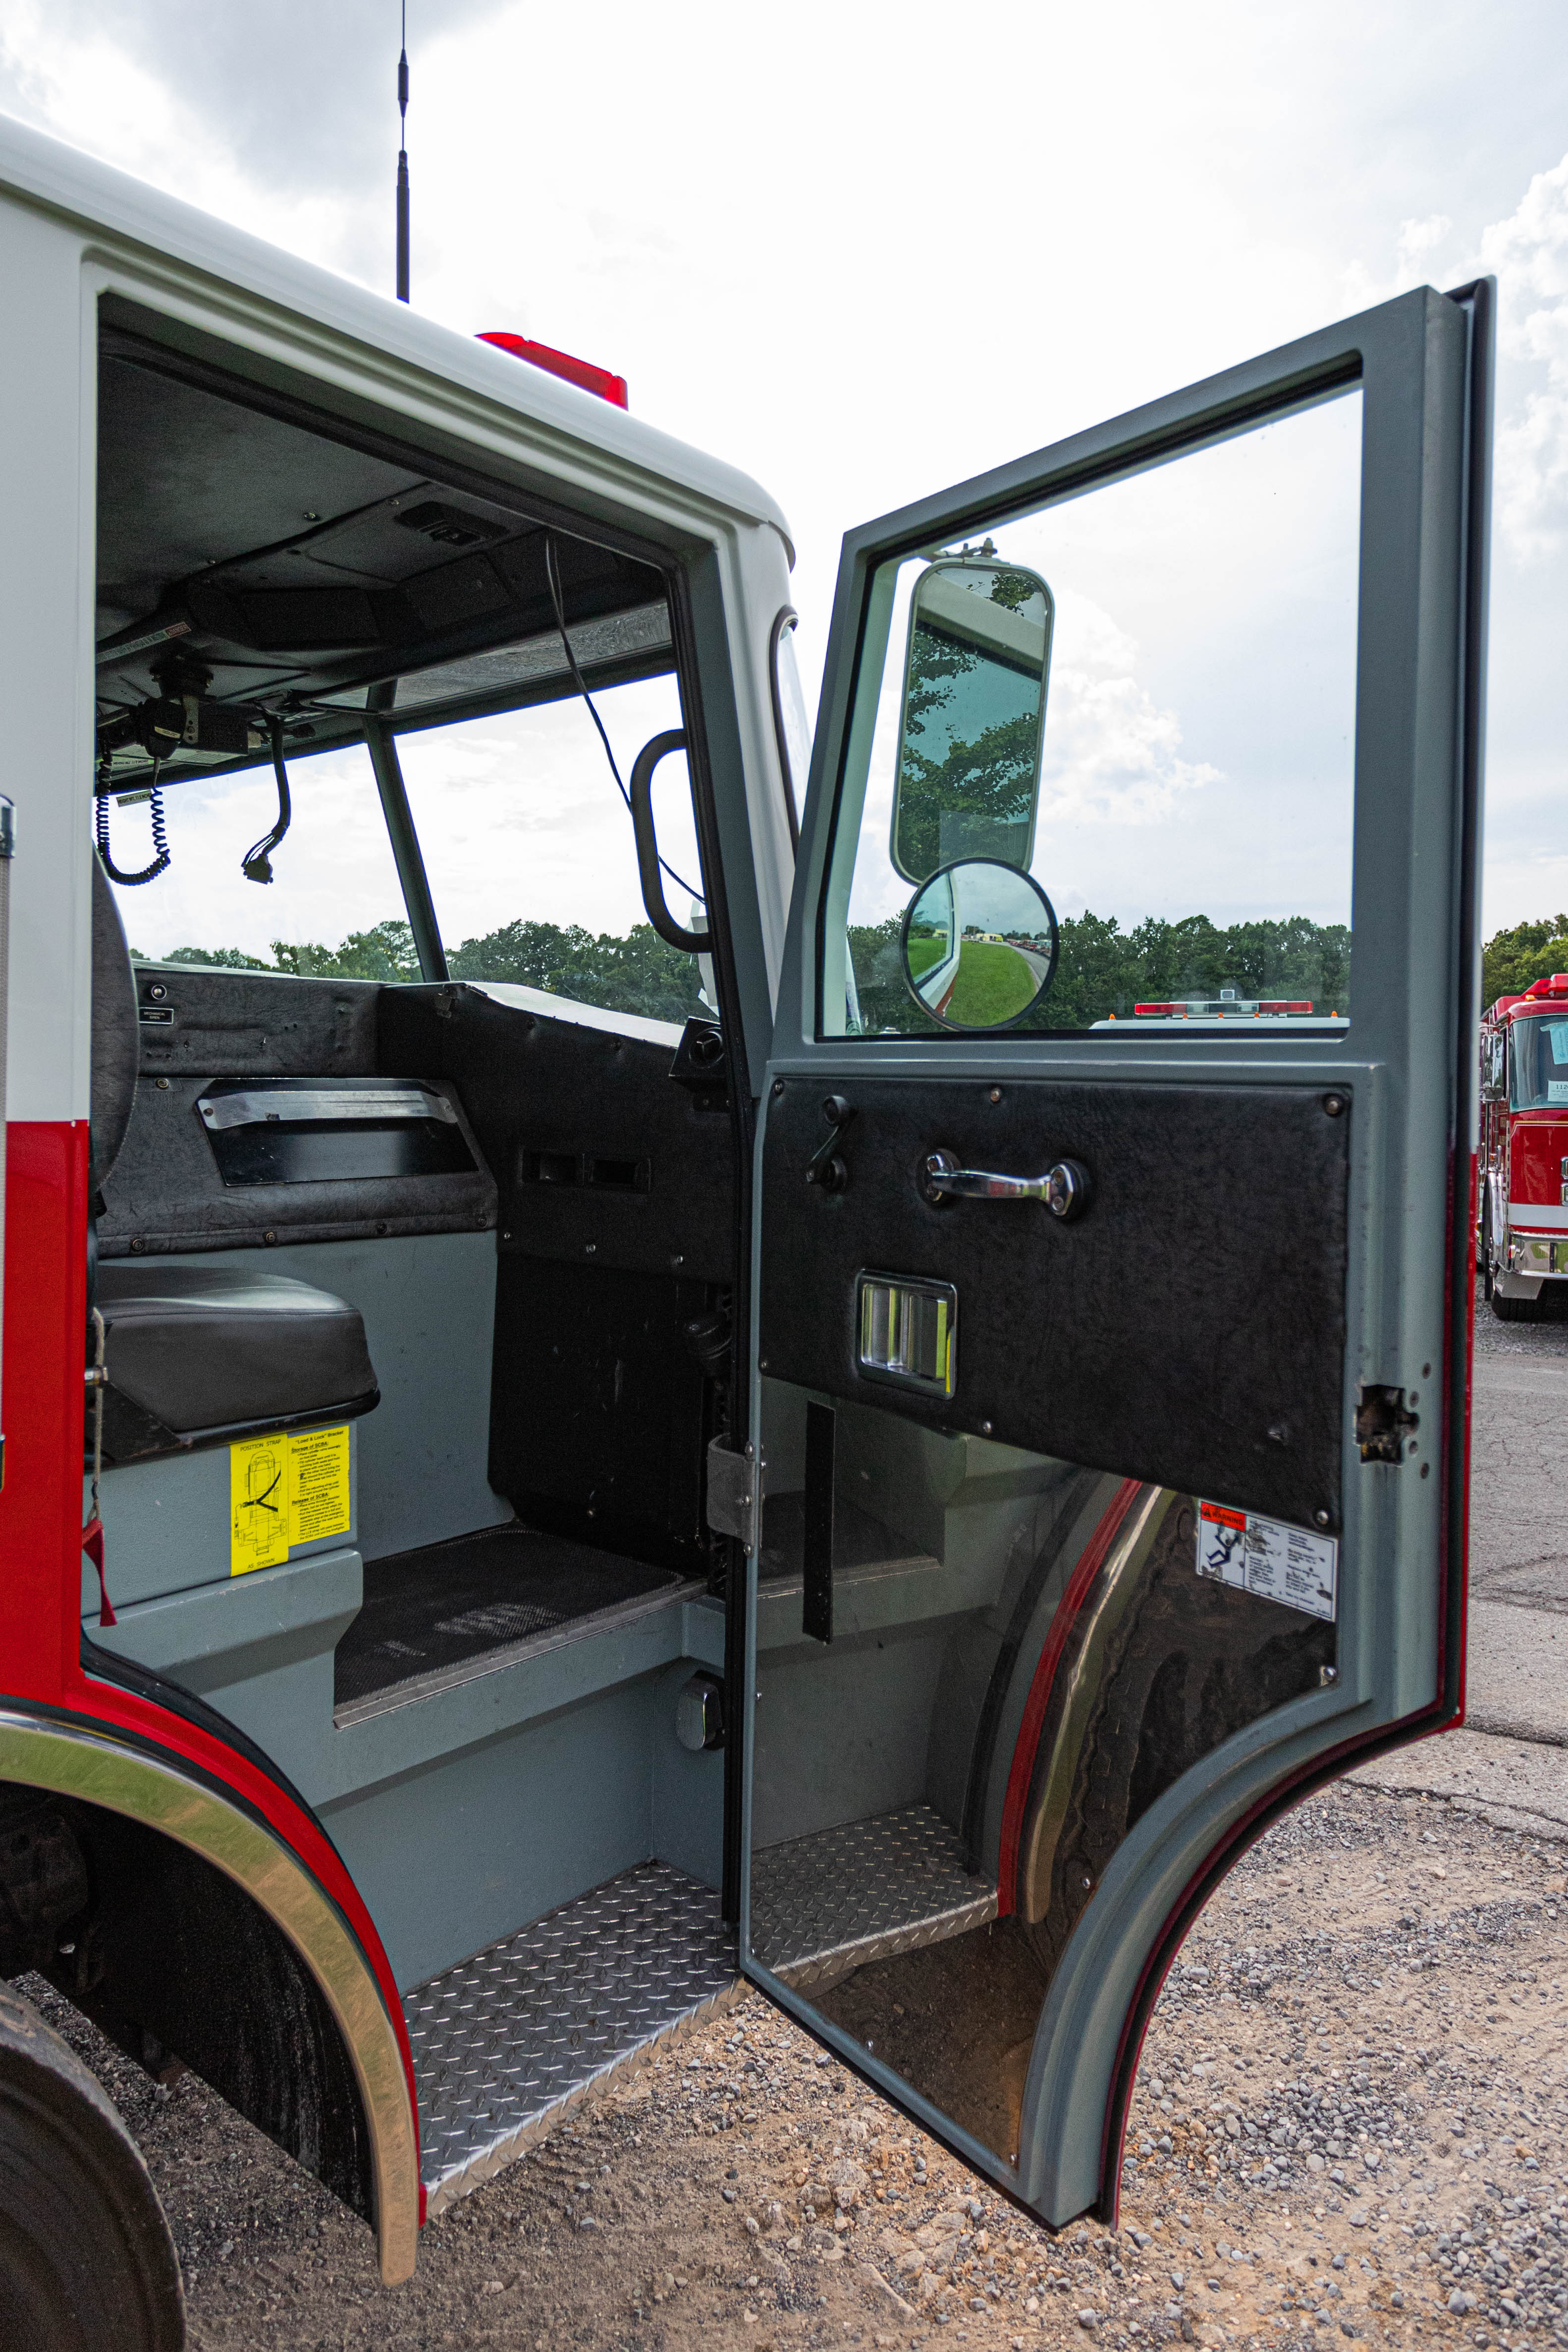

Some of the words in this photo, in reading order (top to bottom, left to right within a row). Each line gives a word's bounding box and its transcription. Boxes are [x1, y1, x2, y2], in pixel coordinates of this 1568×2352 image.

[240, 1443, 264, 1452] POSITION
[1213, 1511, 1243, 1525] WARNING
[257, 1557, 275, 1567] SHOWN
